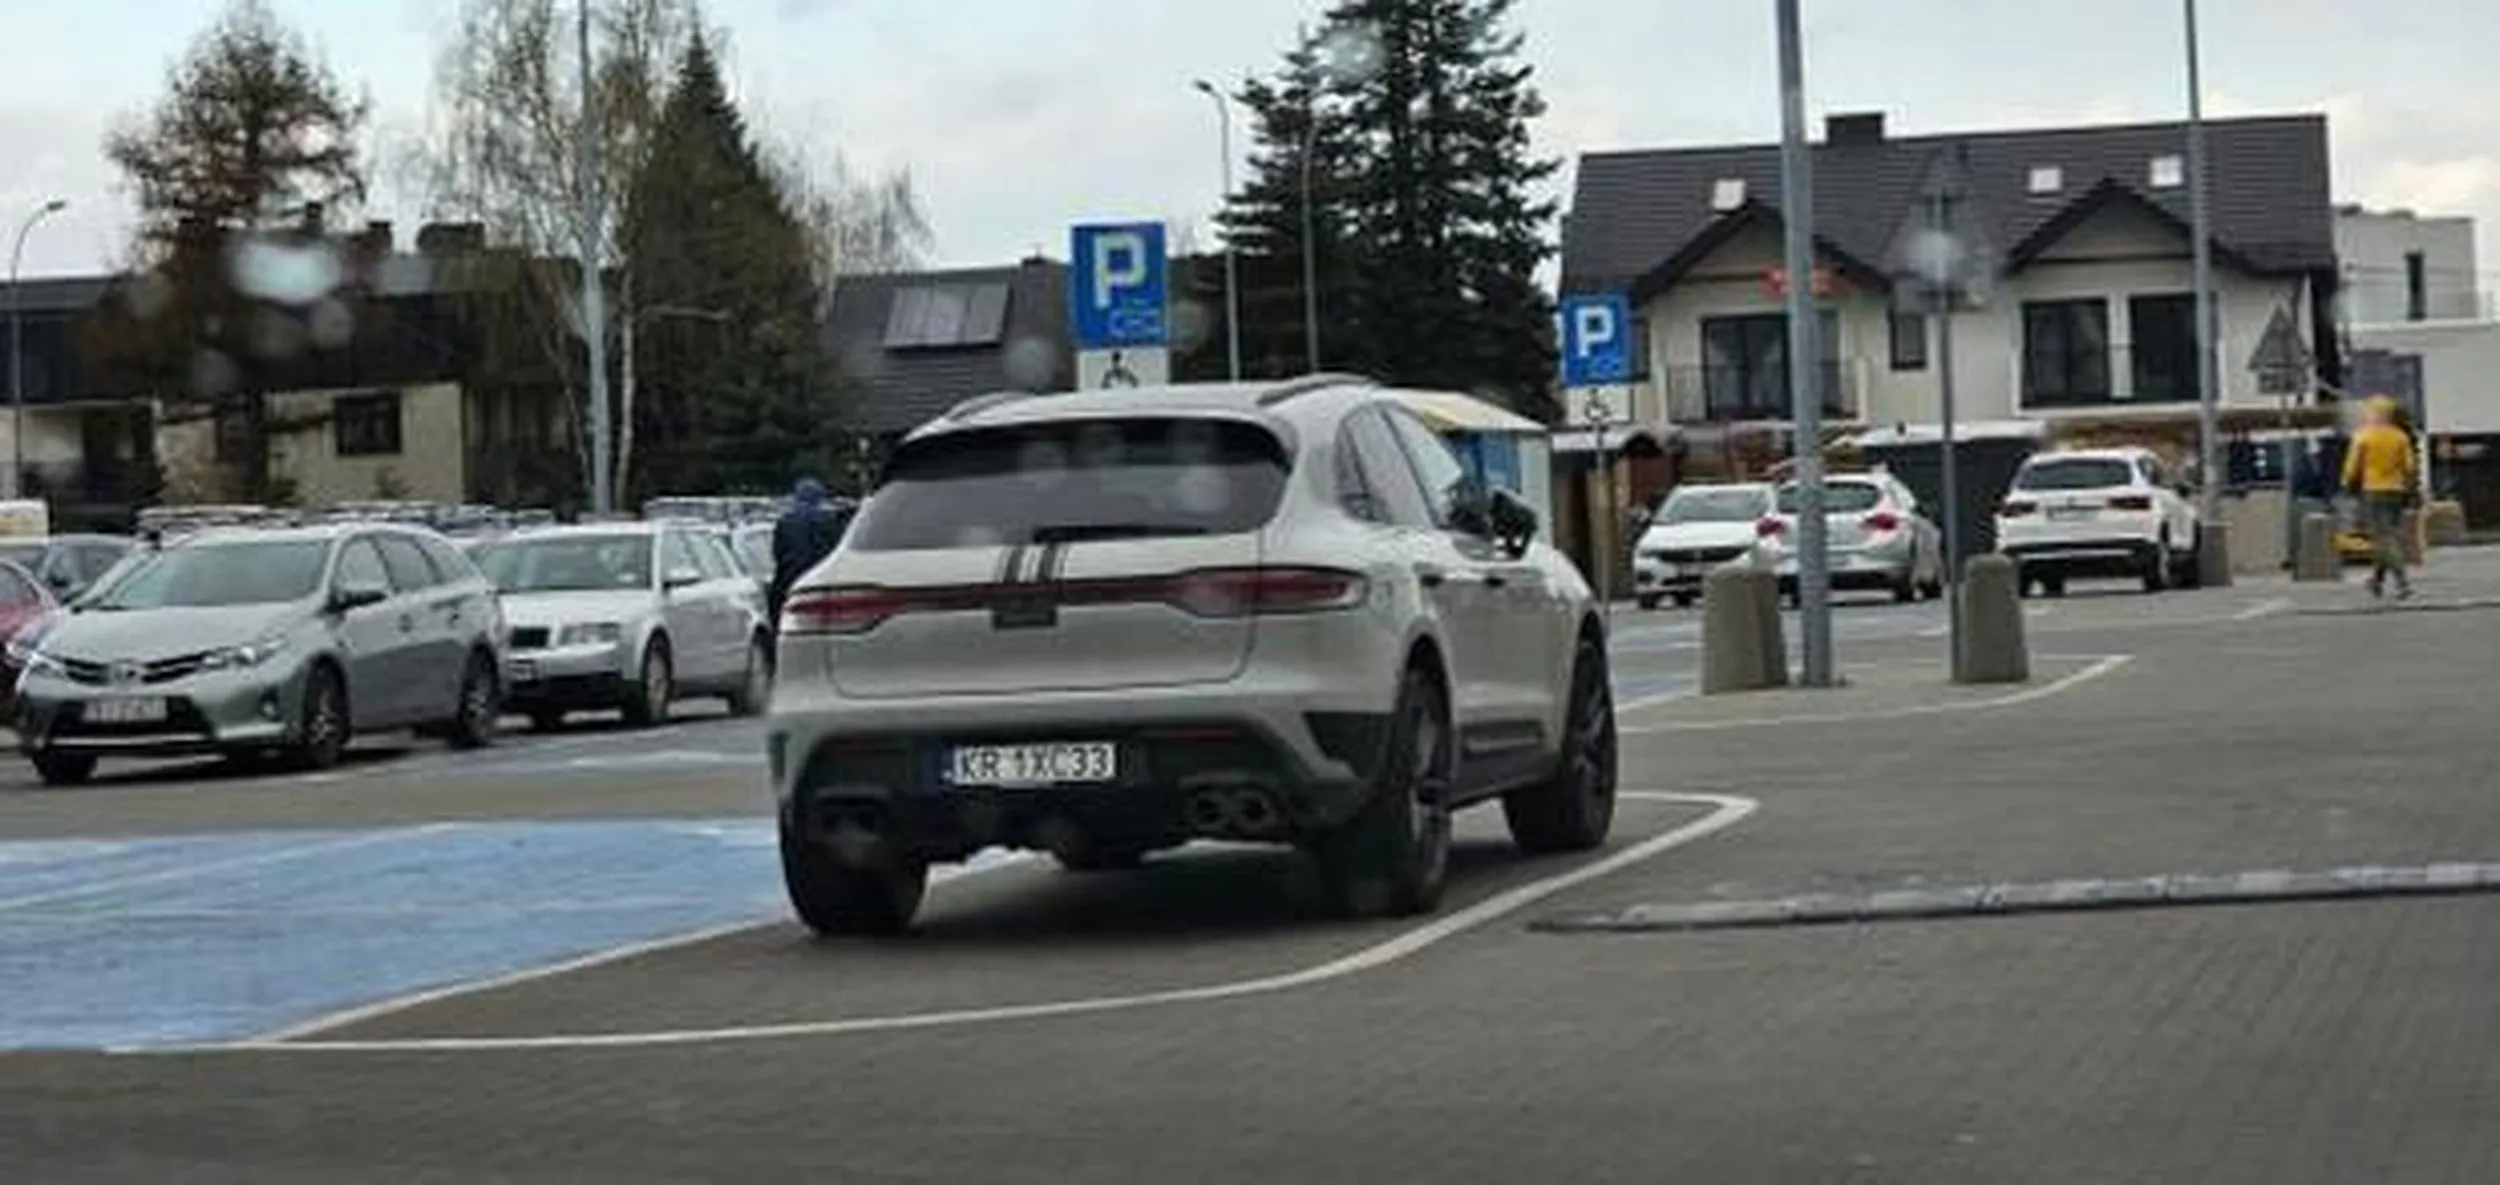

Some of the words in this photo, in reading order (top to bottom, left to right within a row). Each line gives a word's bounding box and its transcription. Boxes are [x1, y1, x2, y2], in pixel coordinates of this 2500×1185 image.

[1093, 233, 1146, 310] P
[1575, 304, 1615, 358] P
[960, 747, 1000, 779] KR
